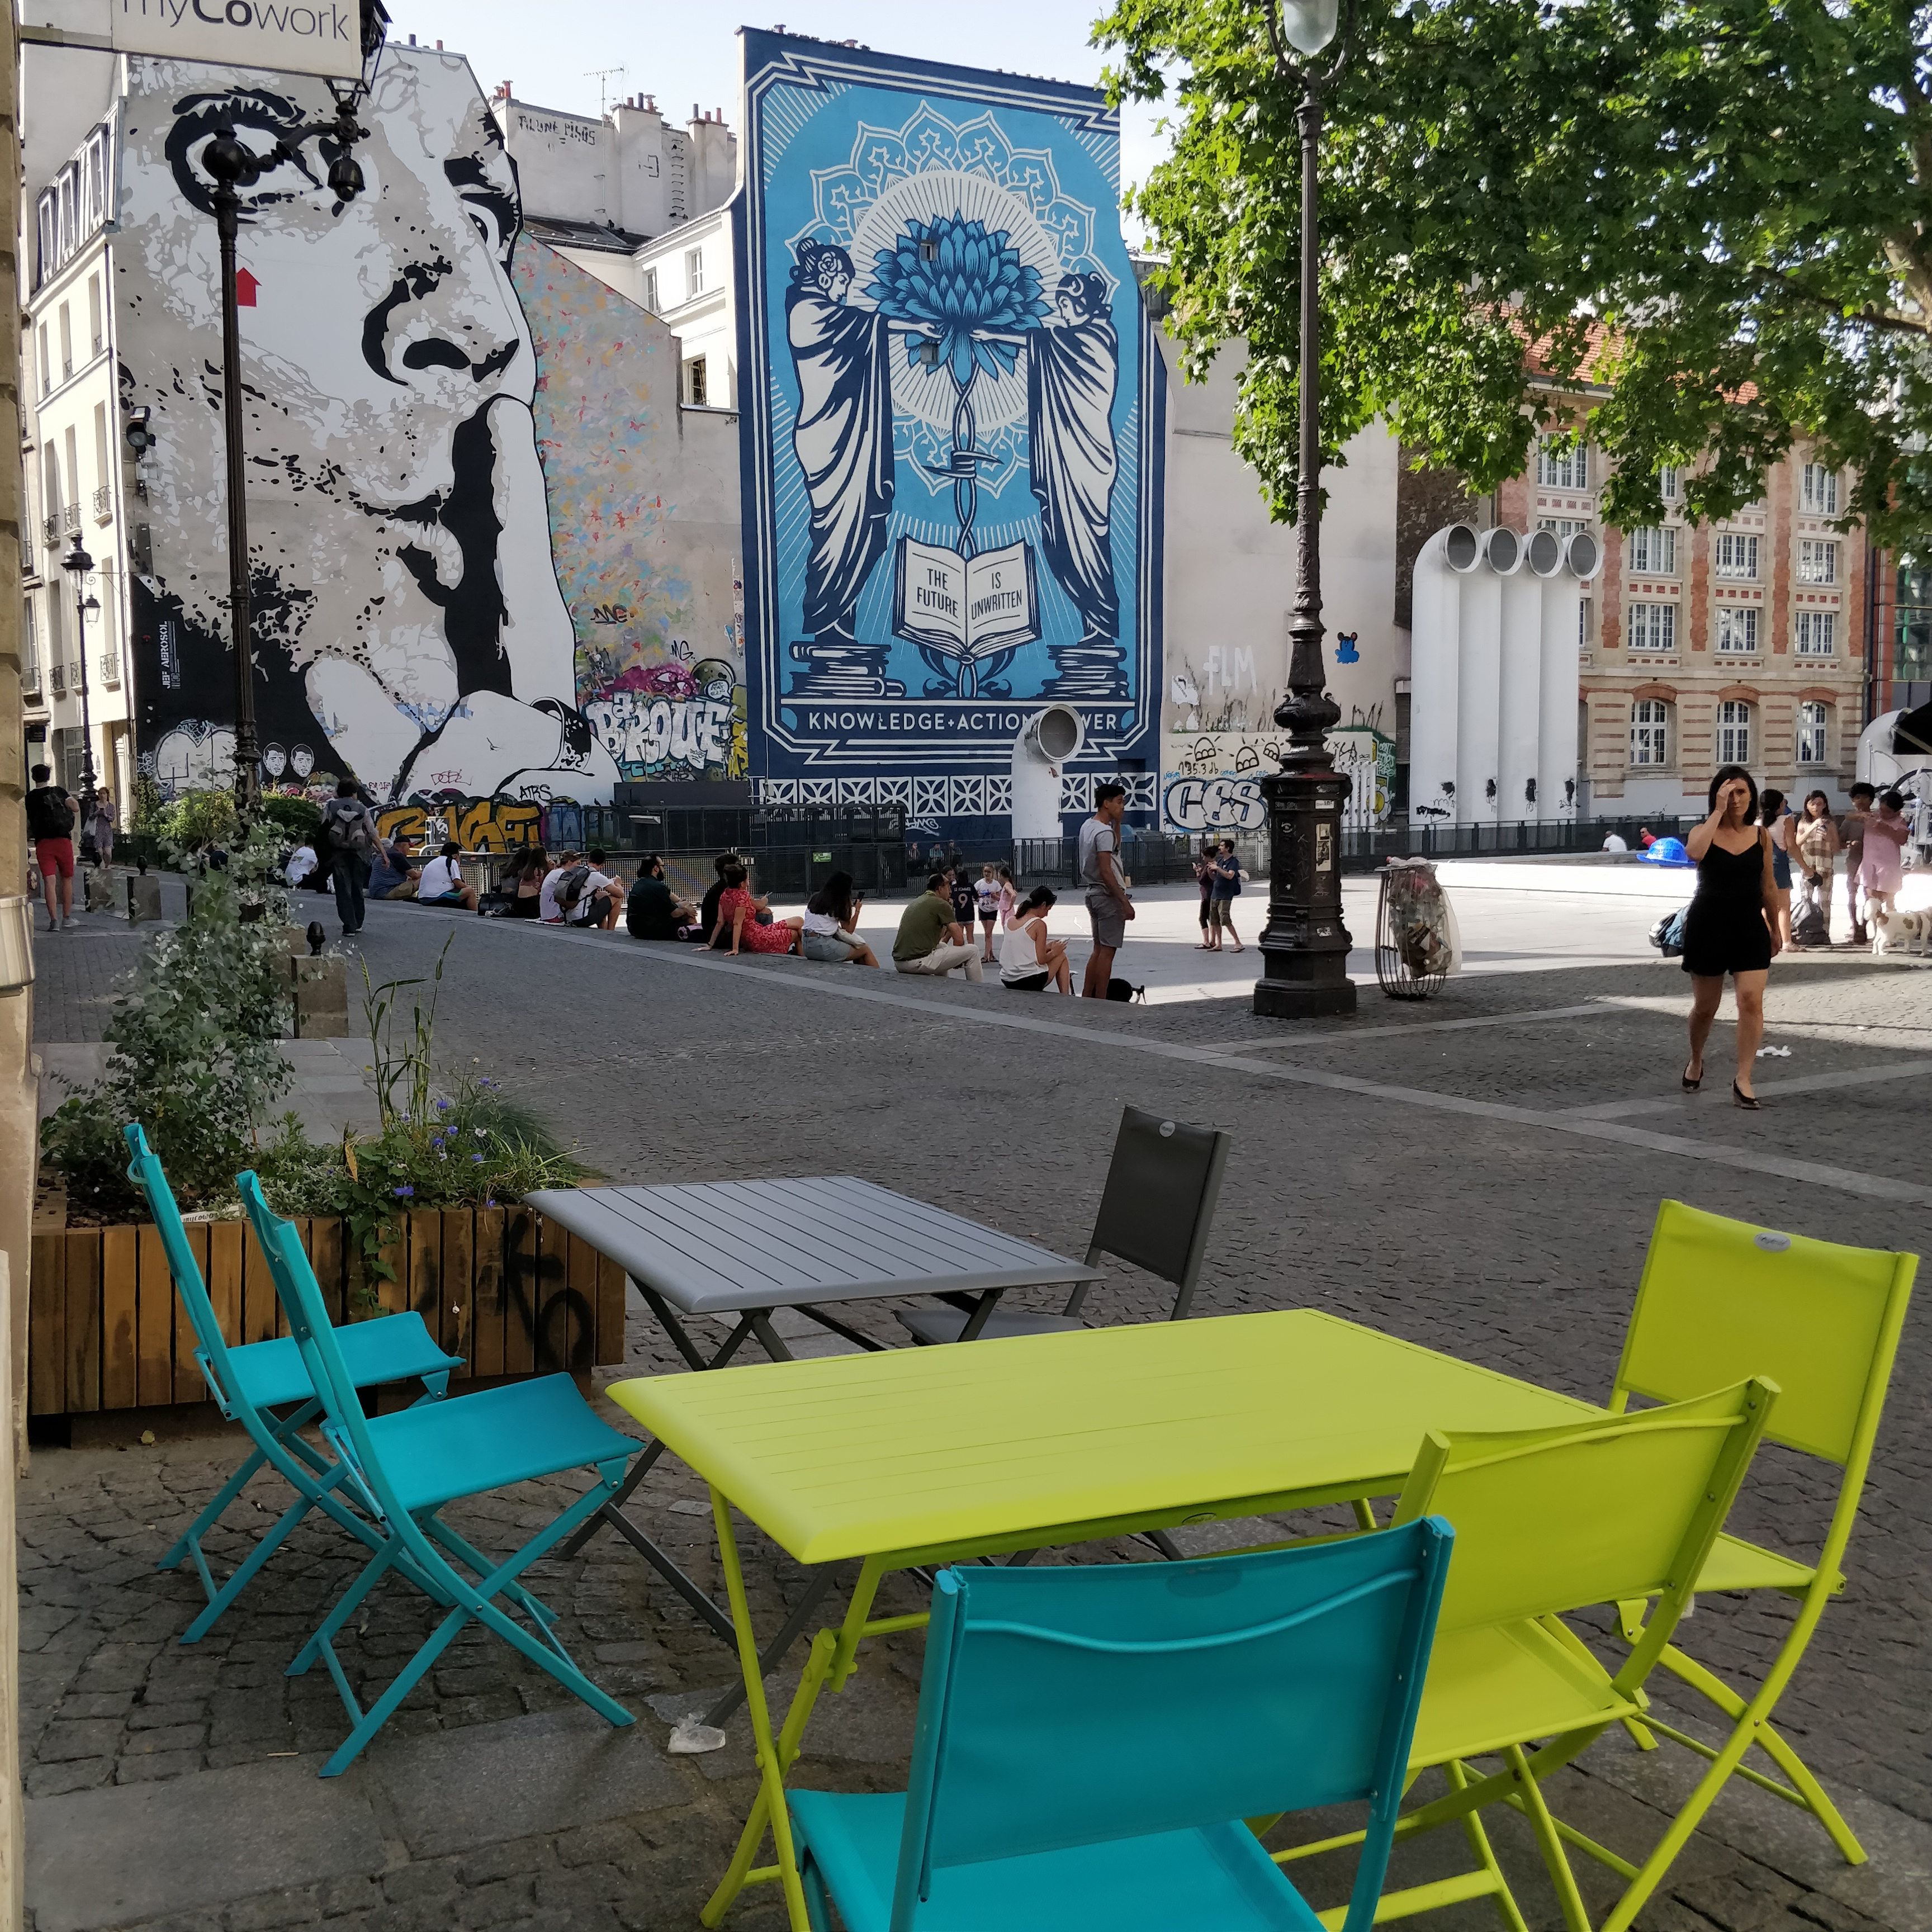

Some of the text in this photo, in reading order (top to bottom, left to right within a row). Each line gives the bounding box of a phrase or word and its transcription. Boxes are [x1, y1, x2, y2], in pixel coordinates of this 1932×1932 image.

[927, 568, 948, 591] THE
[991, 571, 1001, 589] IS
[917, 586, 958, 619] FUTURE
[971, 589, 1022, 620] UNWRITTEN
[159, 621, 171, 689] JEF AEROSOL
[958, 893, 968, 908] 9
